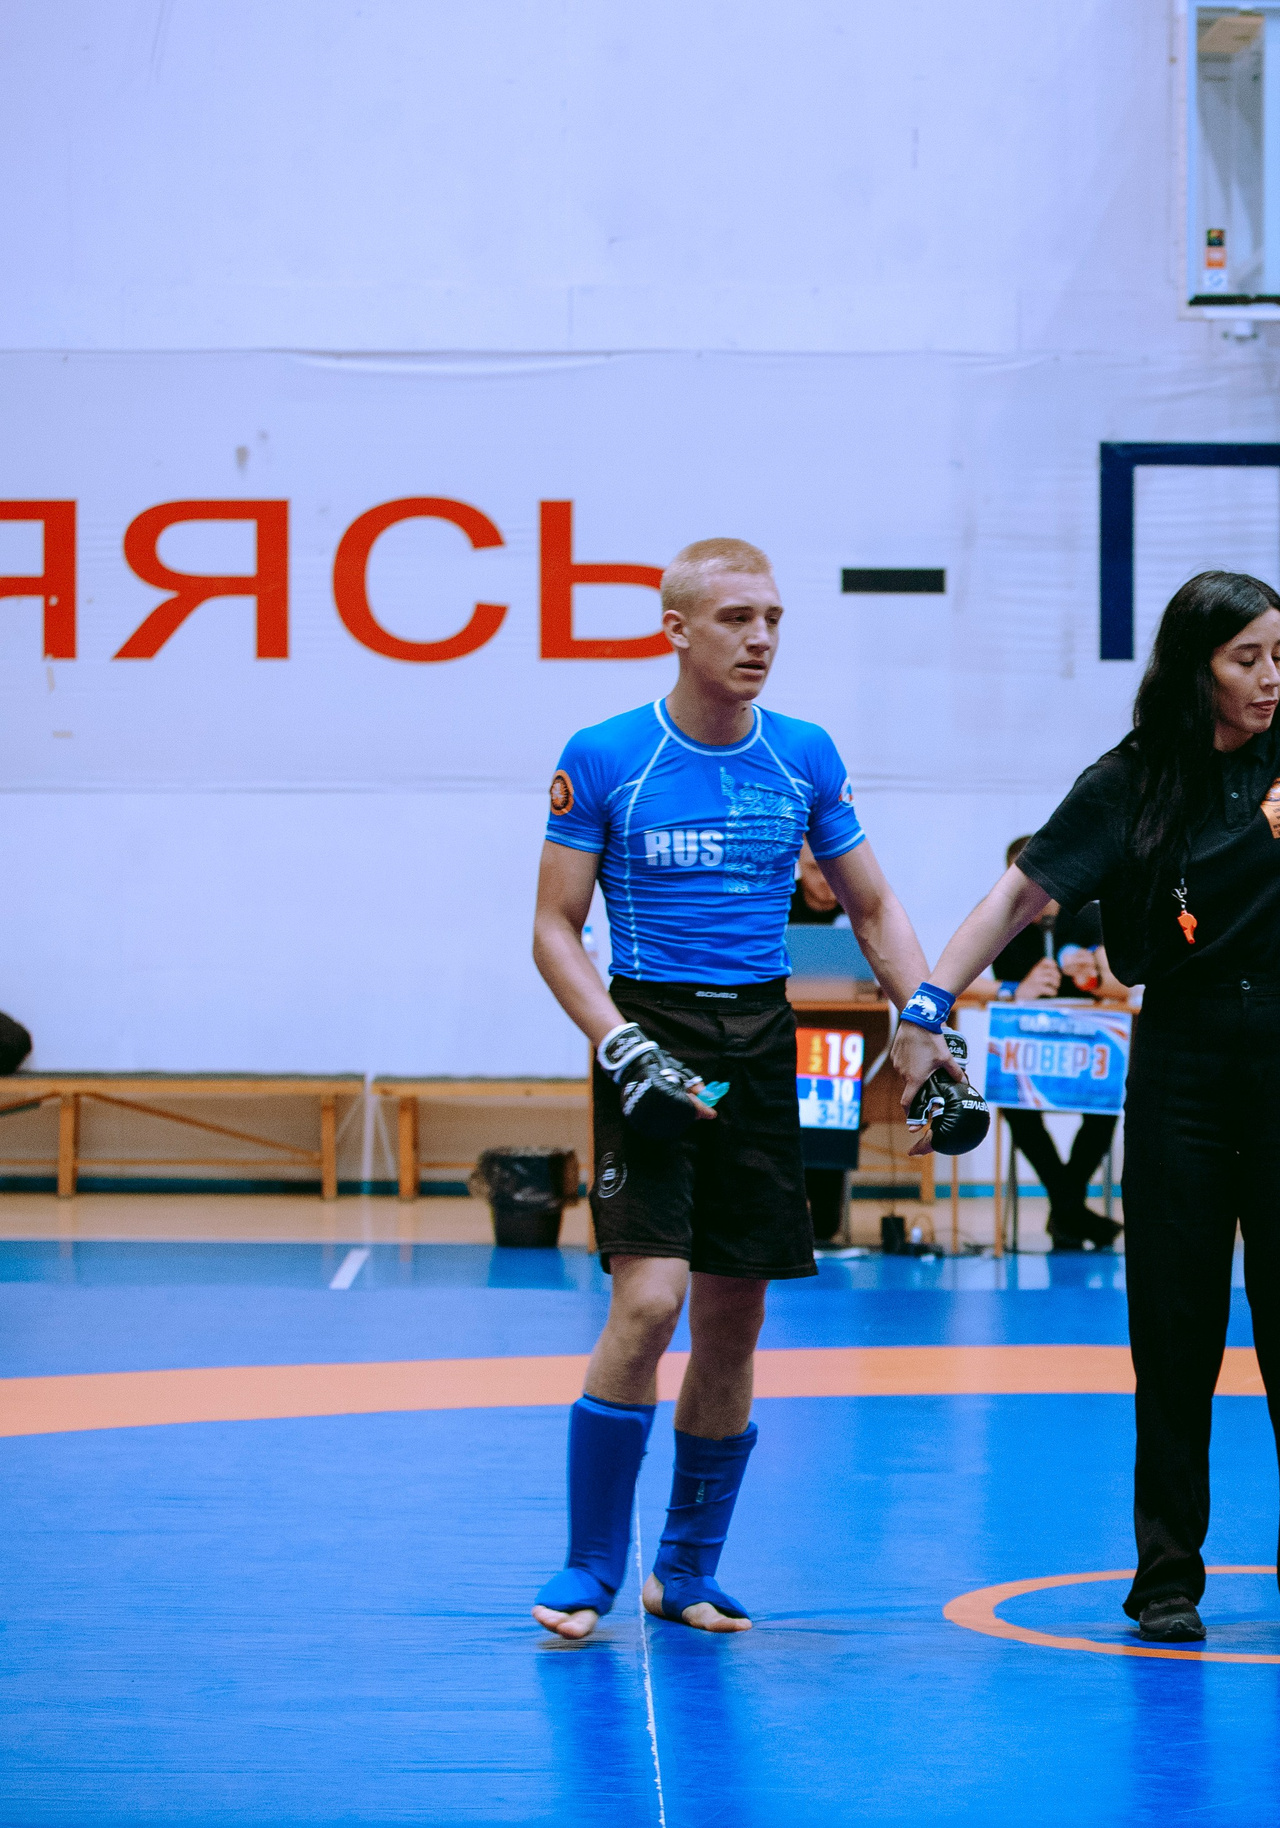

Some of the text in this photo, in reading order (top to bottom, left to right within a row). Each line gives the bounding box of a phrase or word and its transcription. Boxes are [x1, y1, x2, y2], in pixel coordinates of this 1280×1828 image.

[643, 829, 725, 867] RUS
[825, 1032, 865, 1077] 19
[1003, 1040, 1088, 1077] КОВЕР
